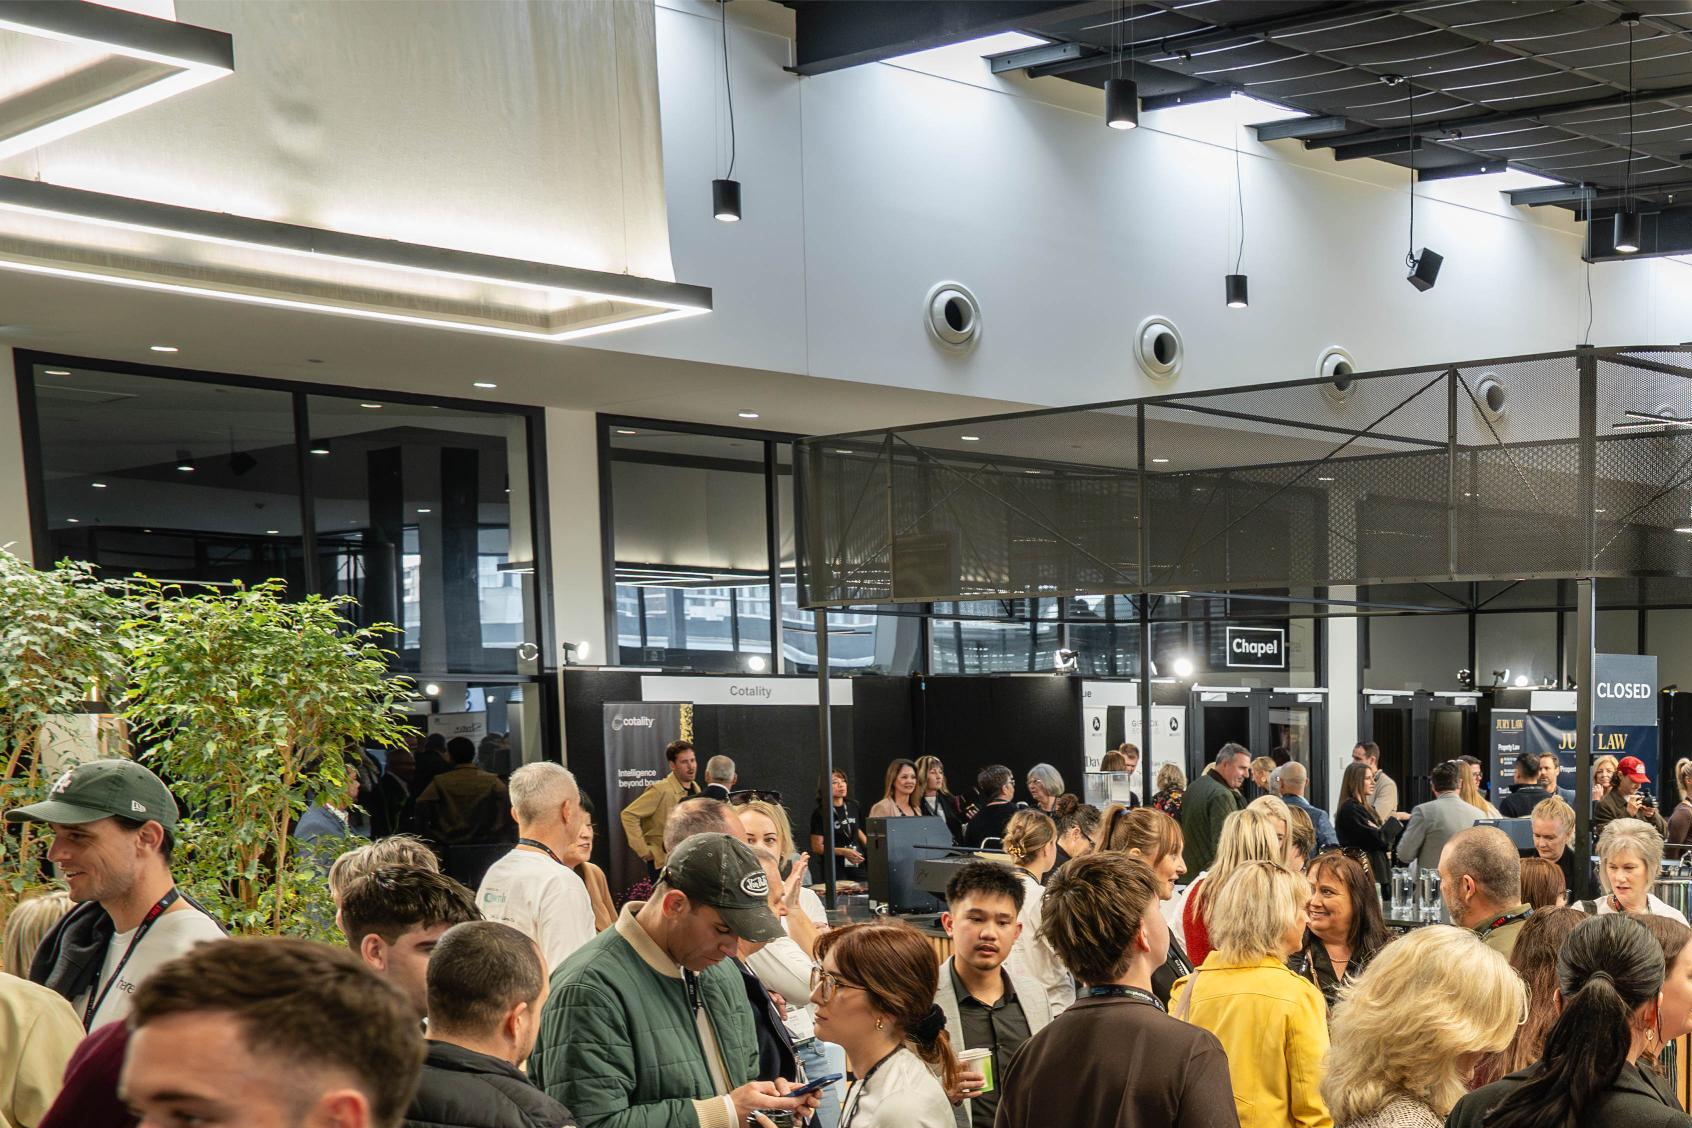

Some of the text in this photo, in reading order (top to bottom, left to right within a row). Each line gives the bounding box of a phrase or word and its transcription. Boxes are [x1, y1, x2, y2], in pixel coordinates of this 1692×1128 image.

[1232, 638, 1278, 658] Chapel
[730, 685, 772, 699] Cotality
[1596, 682, 1651, 699] CLOSED
[622, 716, 655, 728] cotality
[1598, 733, 1628, 750] LAW
[618, 769, 657, 777] Intelligence
[618, 779, 644, 788] beyond
